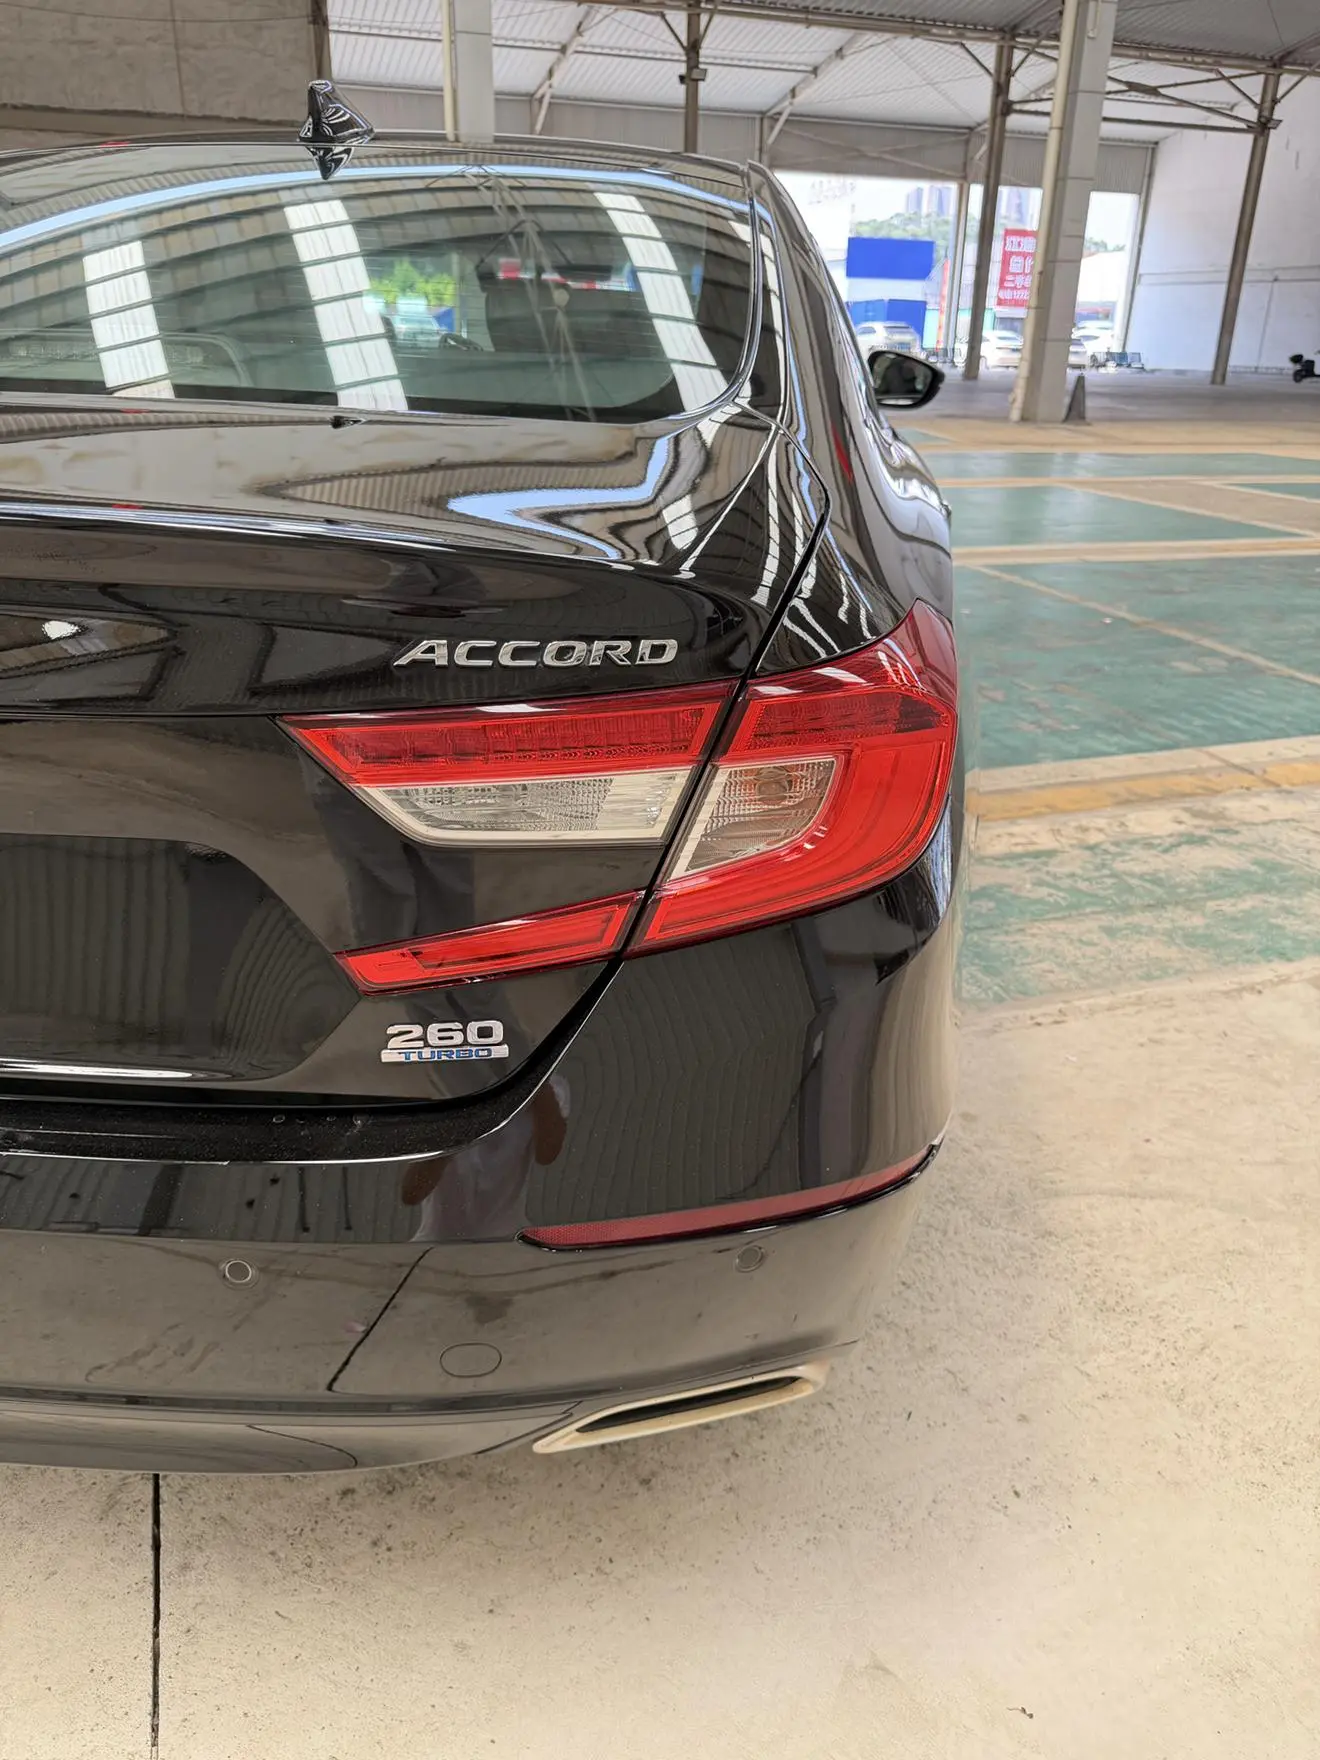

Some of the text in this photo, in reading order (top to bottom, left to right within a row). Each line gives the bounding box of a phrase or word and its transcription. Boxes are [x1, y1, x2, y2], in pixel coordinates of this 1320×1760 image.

[393, 639, 679, 667] ACCORD
[386, 1020, 504, 1049] 260
[398, 1048, 493, 1061] TURBO
